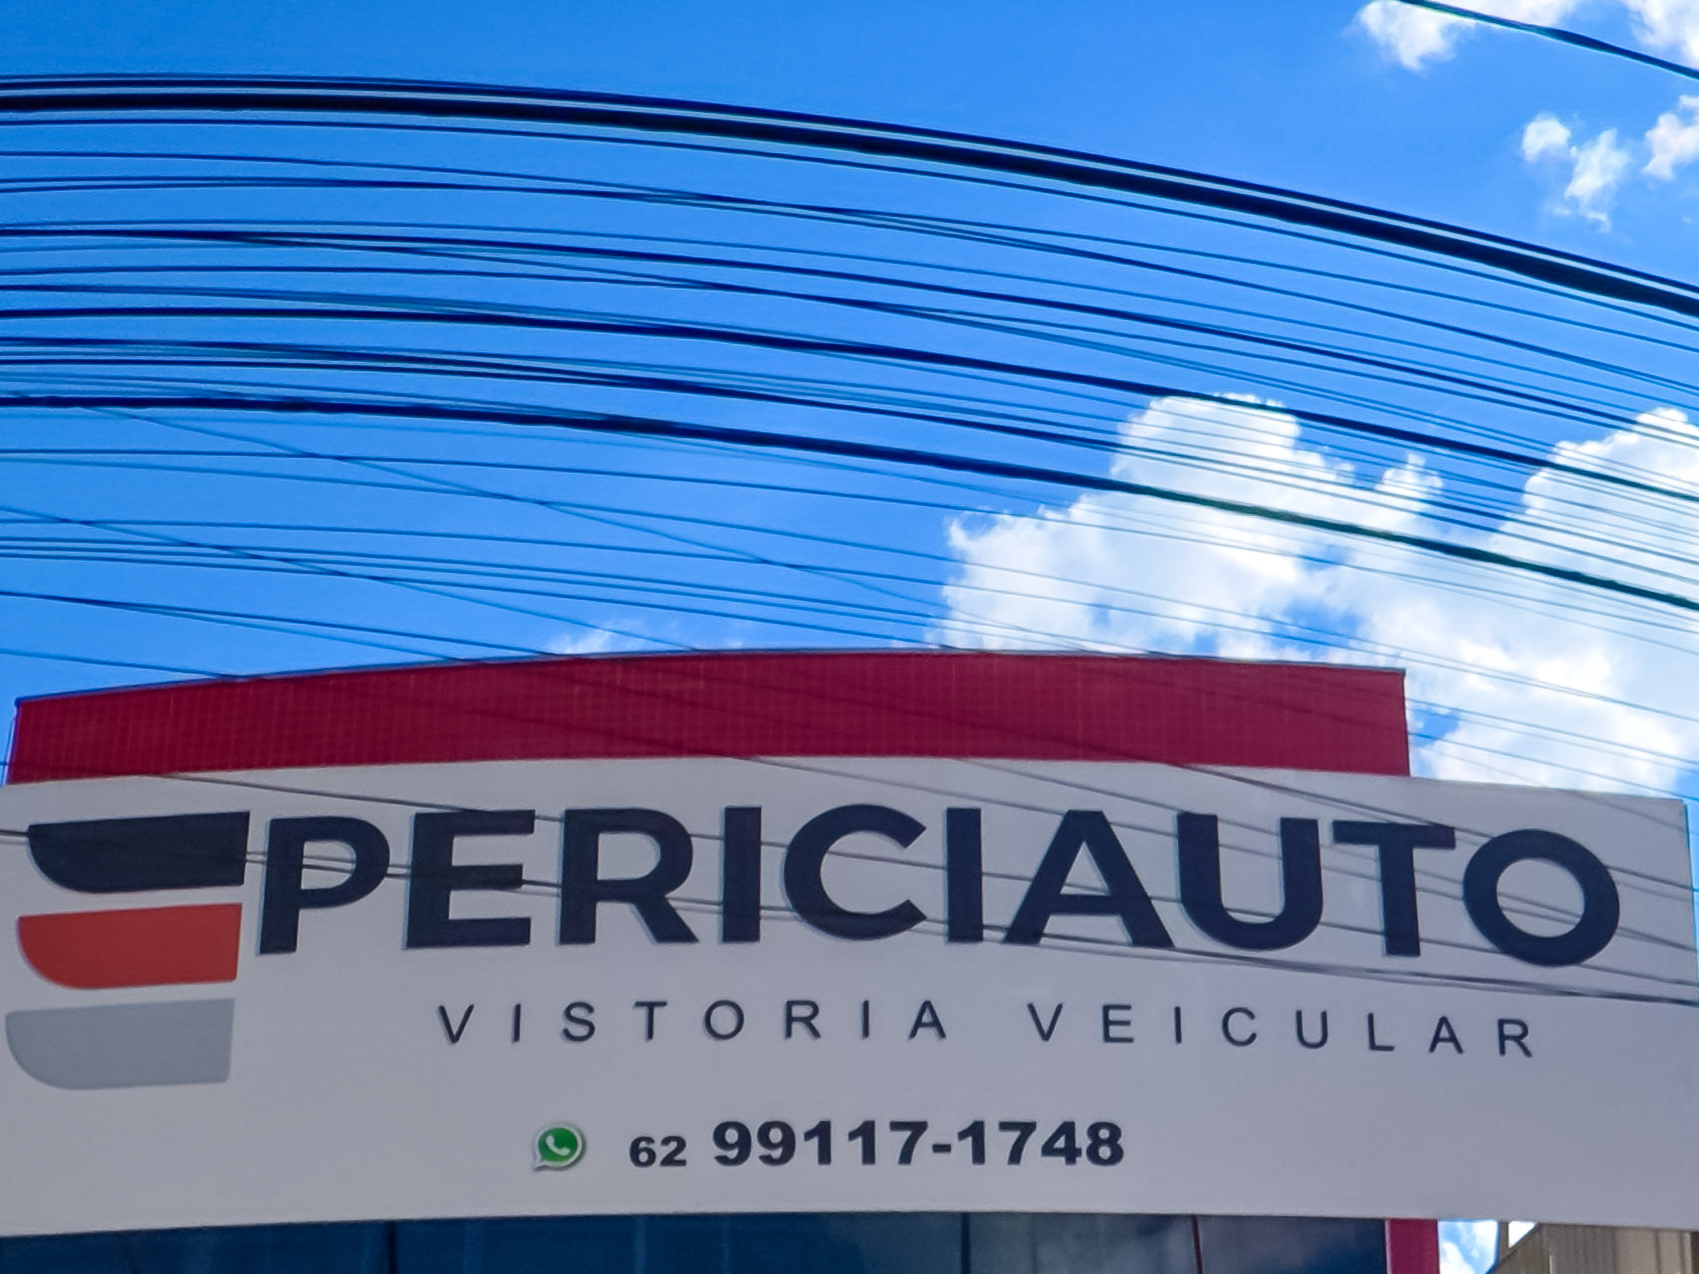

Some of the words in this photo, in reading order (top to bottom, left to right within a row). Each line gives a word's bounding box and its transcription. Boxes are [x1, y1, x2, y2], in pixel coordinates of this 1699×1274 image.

[256, 803, 1622, 969] PERICIAUTO
[436, 1000, 949, 1045] VISTORIA
[1028, 1001, 1536, 1058] VEICULAR
[628, 1135, 688, 1168] 62
[712, 1119, 1126, 1166] 99117-1748
